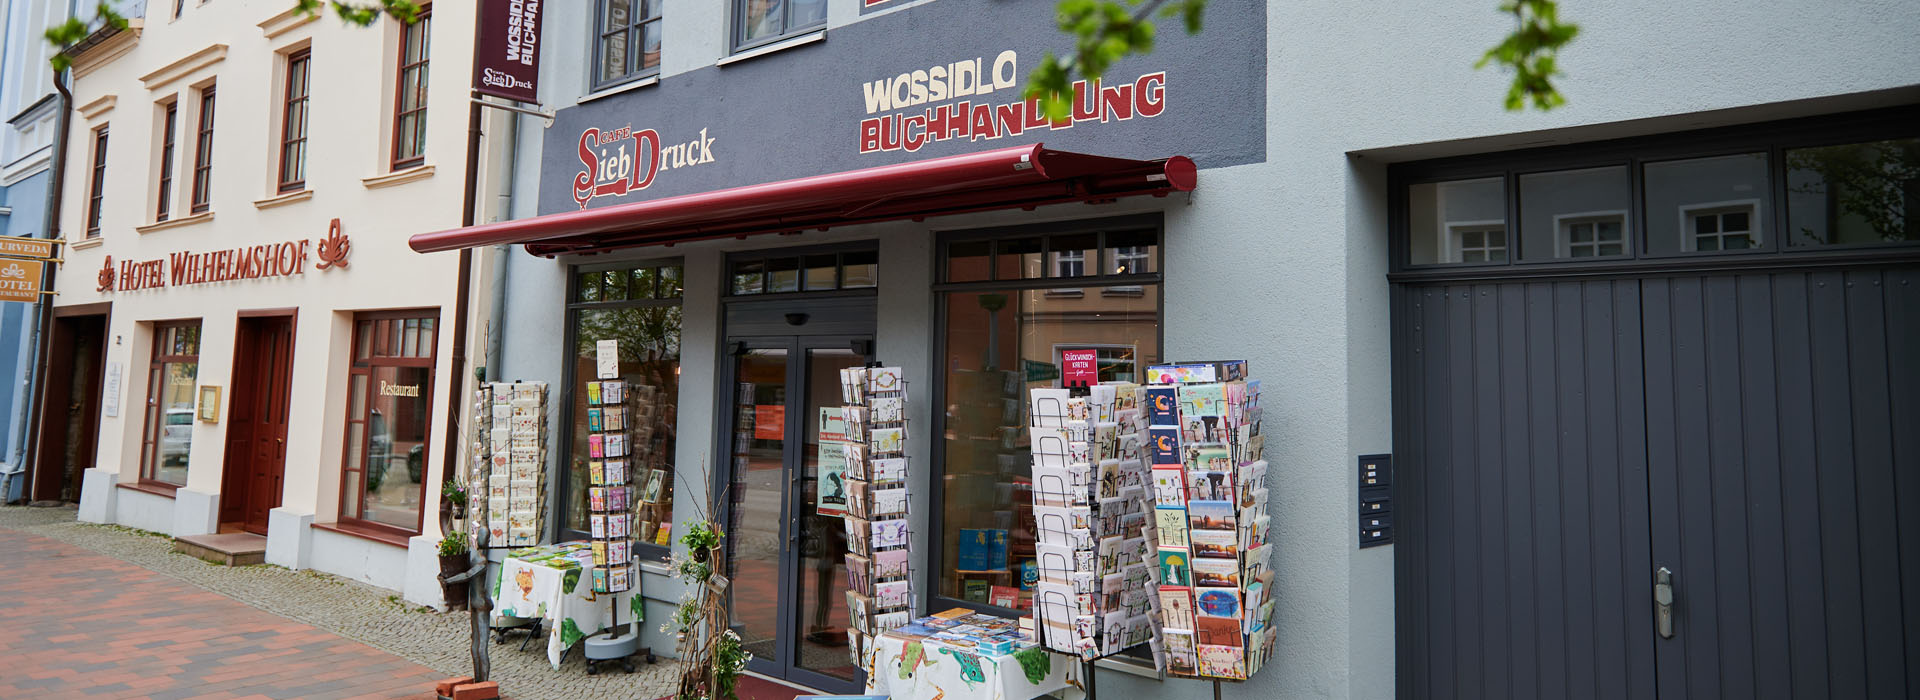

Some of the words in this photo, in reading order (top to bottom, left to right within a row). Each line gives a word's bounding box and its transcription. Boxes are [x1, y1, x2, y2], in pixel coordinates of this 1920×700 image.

[521, 0, 539, 65] BUCHHA
[863, 50, 1017, 114] WOSSIDLO
[118, 259, 165, 292] HOTEL
[169, 239, 309, 287] WILHELMSHOF
[380, 380, 419, 397] Restaurant
[1072, 361, 1089, 369] KARTEN
